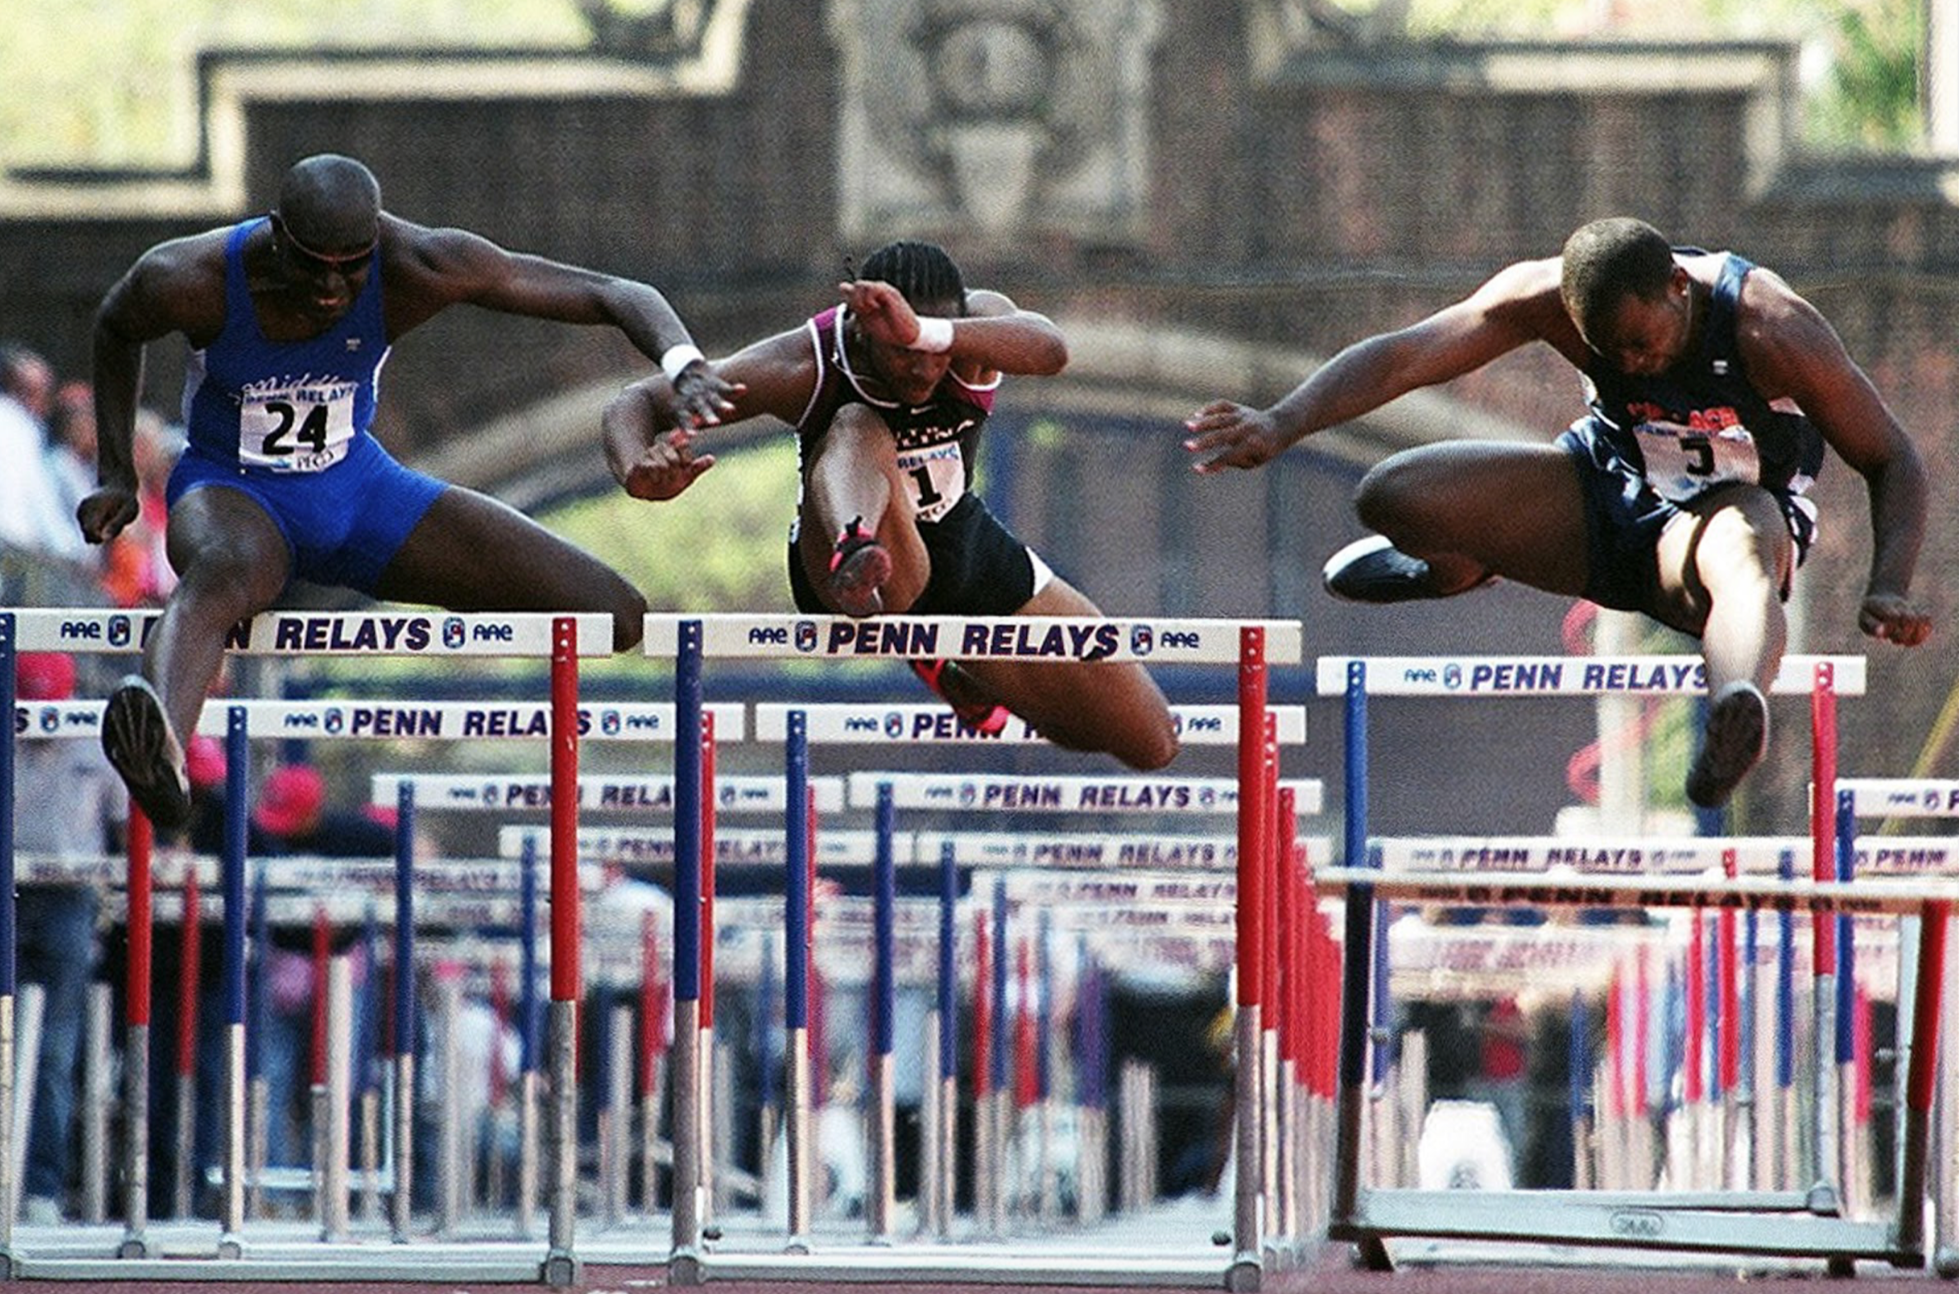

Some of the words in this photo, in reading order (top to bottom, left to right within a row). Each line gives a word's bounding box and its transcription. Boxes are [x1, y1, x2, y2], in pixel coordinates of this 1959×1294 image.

[262, 402, 329, 455] 24
[908, 465, 943, 508] 1
[275, 617, 431, 650] RELAYS
[827, 621, 938, 654] PENN
[962, 623, 1119, 659] RELAYS
[1471, 663, 1563, 690] PENN
[1583, 663, 1708, 690] RELAYS
[352, 709, 443, 736] PENN
[464, 710, 592, 736] RELAS
[912, 713, 1001, 739] PE
[507, 784, 583, 804] PE
[602, 784, 672, 805] RELA
[983, 784, 1061, 807] PENN
[1079, 785, 1190, 808] RELAYS
[1460, 848, 1528, 869] PENN
[1547, 848, 1642, 868] RELAYS
